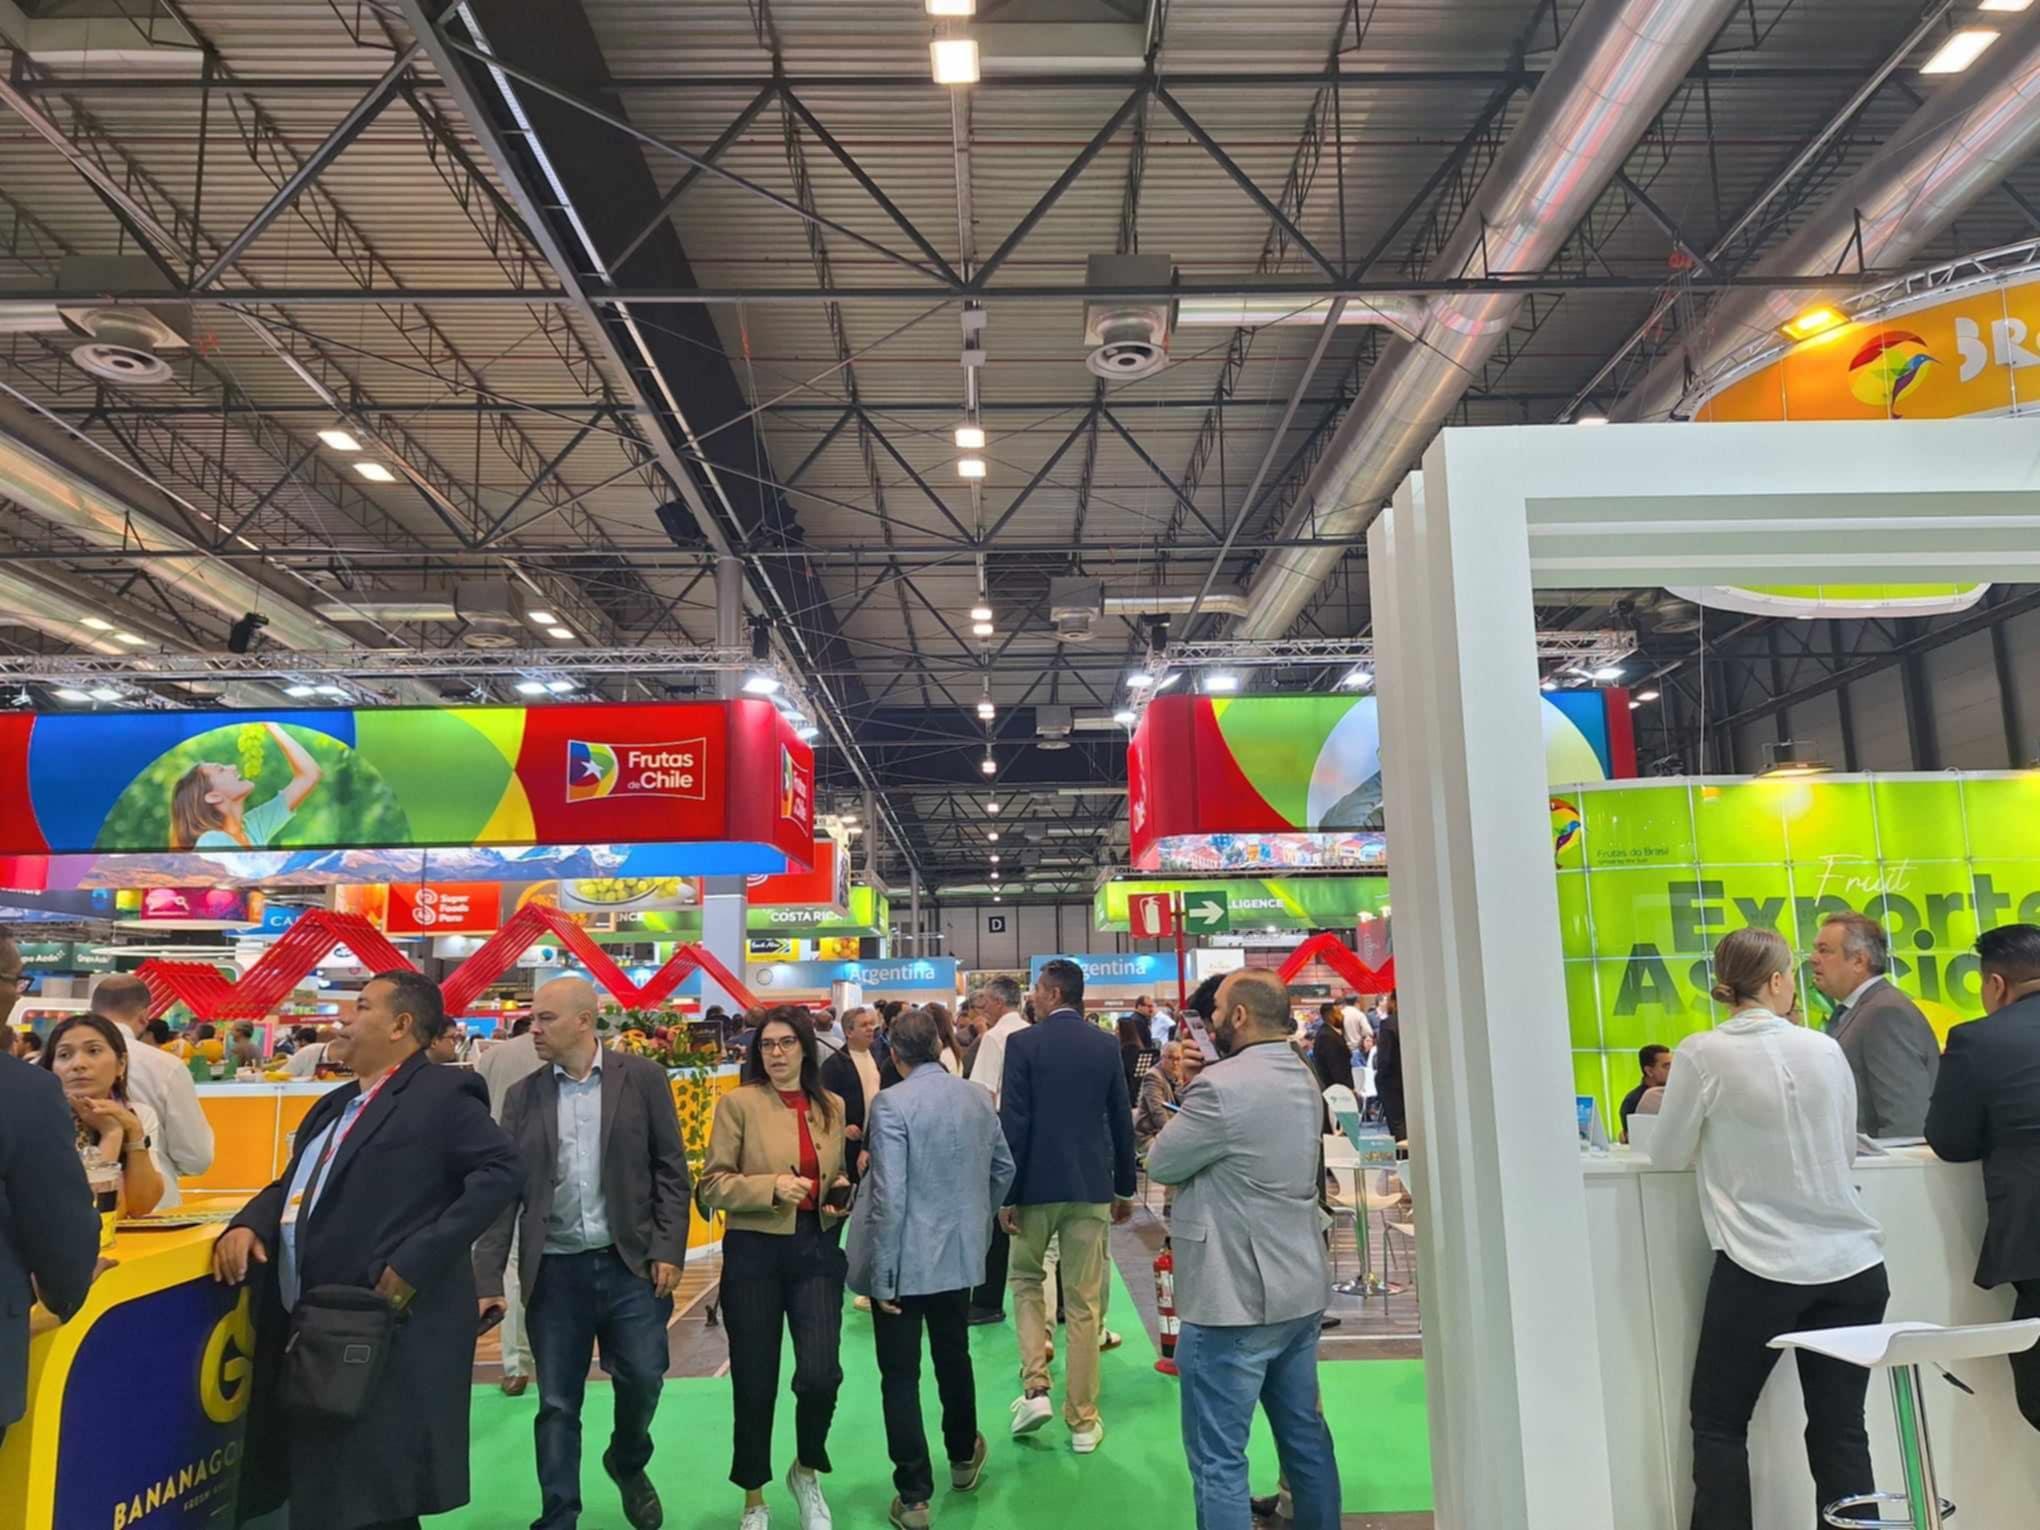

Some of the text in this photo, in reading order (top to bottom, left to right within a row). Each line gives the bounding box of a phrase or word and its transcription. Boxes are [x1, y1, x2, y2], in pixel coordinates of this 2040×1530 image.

[1955, 316, 2040, 384] BR
[628, 751, 694, 768] Frutas
[628, 770, 694, 790] de Chile
[1816, 854, 1918, 907] Fruit
[770, 911, 811, 922] COSTA
[991, 918, 1002, 930] D
[850, 962, 935, 985] Argentina
